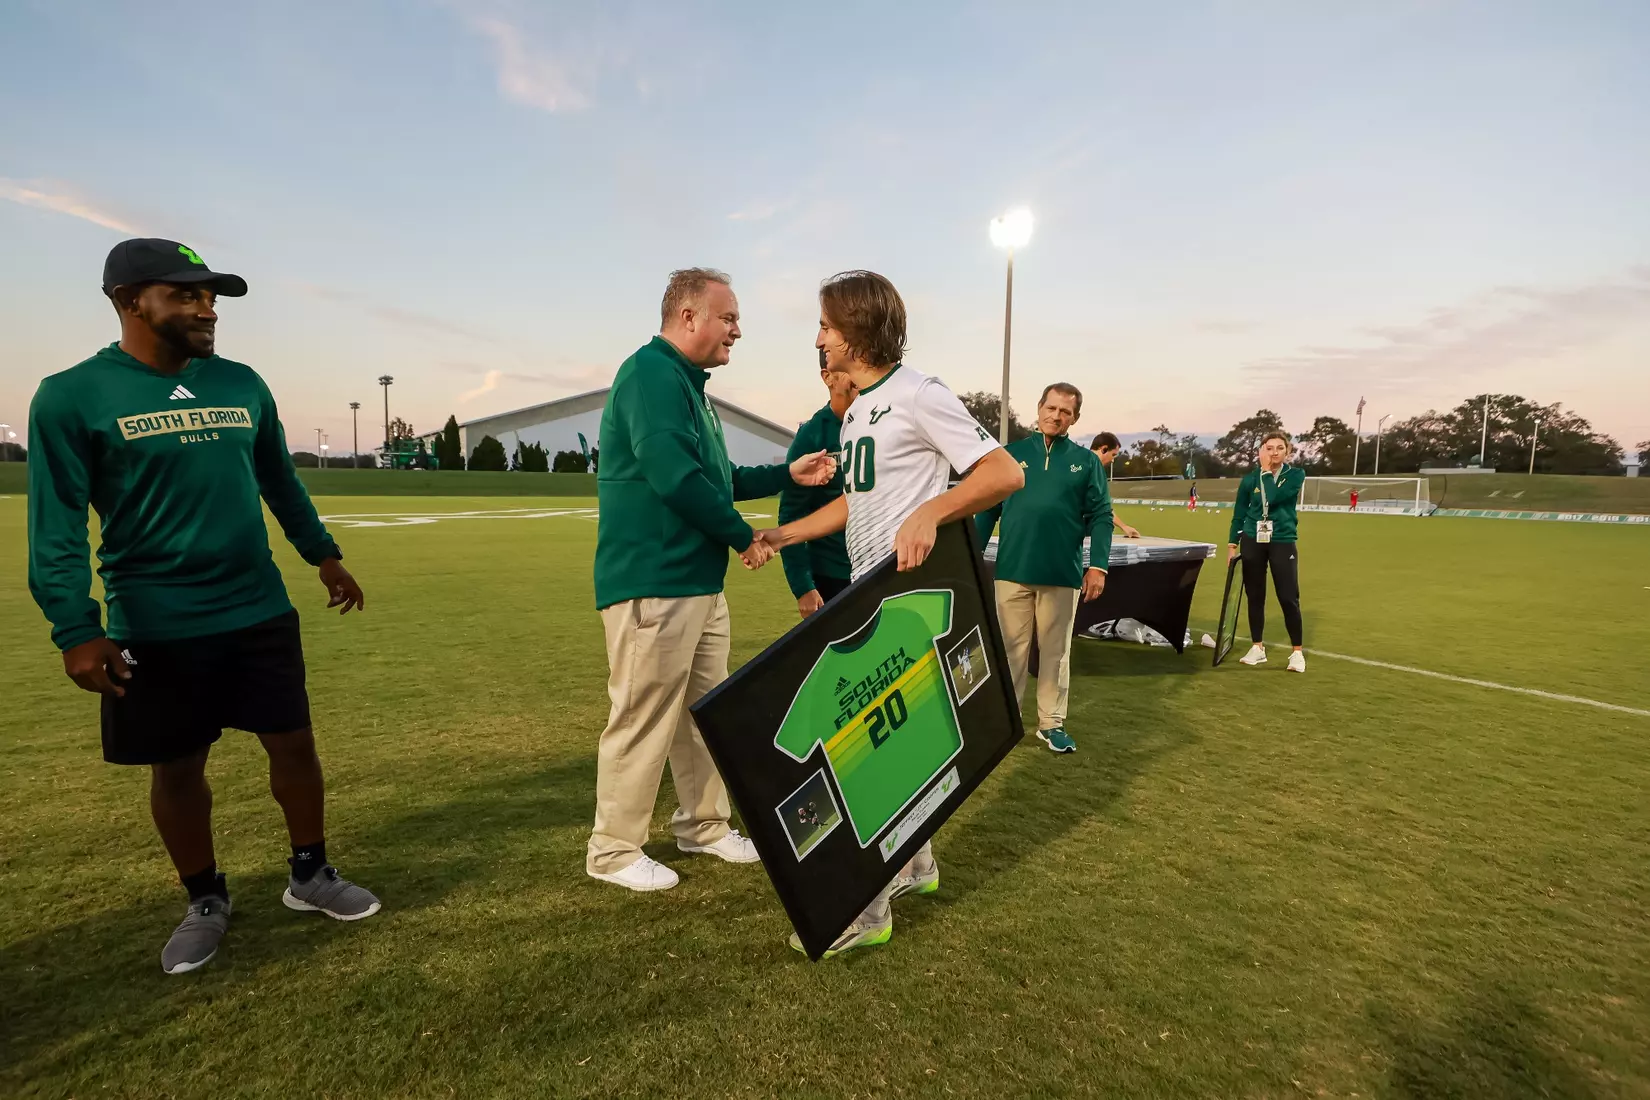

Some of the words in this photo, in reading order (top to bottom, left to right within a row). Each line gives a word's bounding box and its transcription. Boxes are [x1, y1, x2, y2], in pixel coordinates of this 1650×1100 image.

[123, 413, 185, 436] SOUTH
[188, 410, 249, 427] FLORIDA
[179, 432, 220, 444] BULLS
[842, 436, 876, 494] 20
[1626, 515, 1650, 523] 201
[833, 656, 917, 730] FLORIDA
[838, 646, 907, 711] SOUTH
[863, 688, 908, 750] 20
